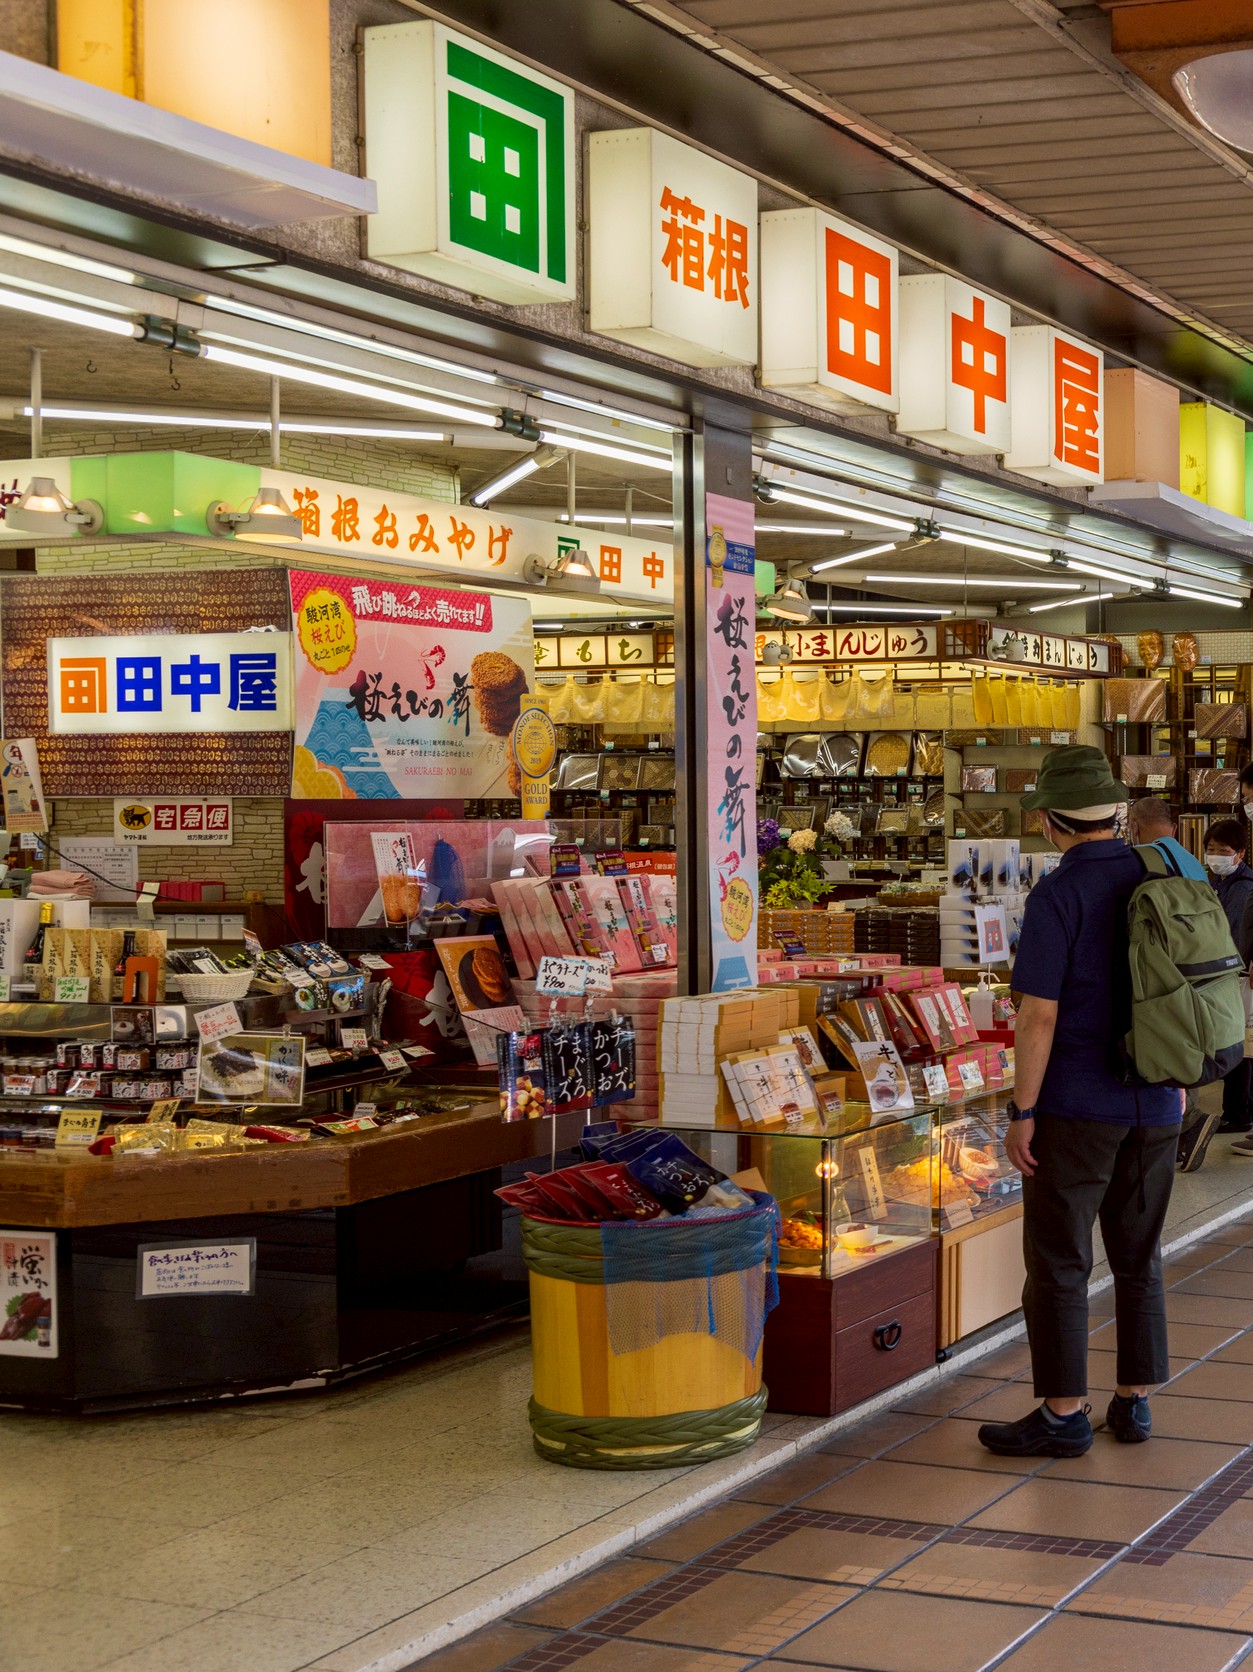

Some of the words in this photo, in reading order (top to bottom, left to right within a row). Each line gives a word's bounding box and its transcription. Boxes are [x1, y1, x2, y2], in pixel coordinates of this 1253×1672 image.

[659, 186, 750, 310] 箱根
[293, 487, 514, 567] 箱根おみやげ
[305, 600, 342, 624] 駿河湾
[311, 619, 347, 646] 桜えび
[116, 652, 278, 712] 田中屋
[346, 669, 475, 737] 桜えびの舞
[516, 715, 532, 745] MONDE
[531, 712, 555, 746] SELECTION
[714, 592, 750, 858] 桜えびの舞
[404, 767, 443, 775] SAKURAEBI
[446, 768, 457, 776] NO
[460, 768, 473, 776] MAI
[525, 783, 548, 794] GOLD
[525, 796, 548, 805] AWARD
[157, 808, 228, 829] 宅急便
[541, 959, 585, 977] まぐろチーズ
[554, 1034, 573, 1102] チーズ
[571, 1032, 586, 1099] まぐろ
[594, 1030, 613, 1091] かつお
[610, 1027, 629, 1091] チーズ
